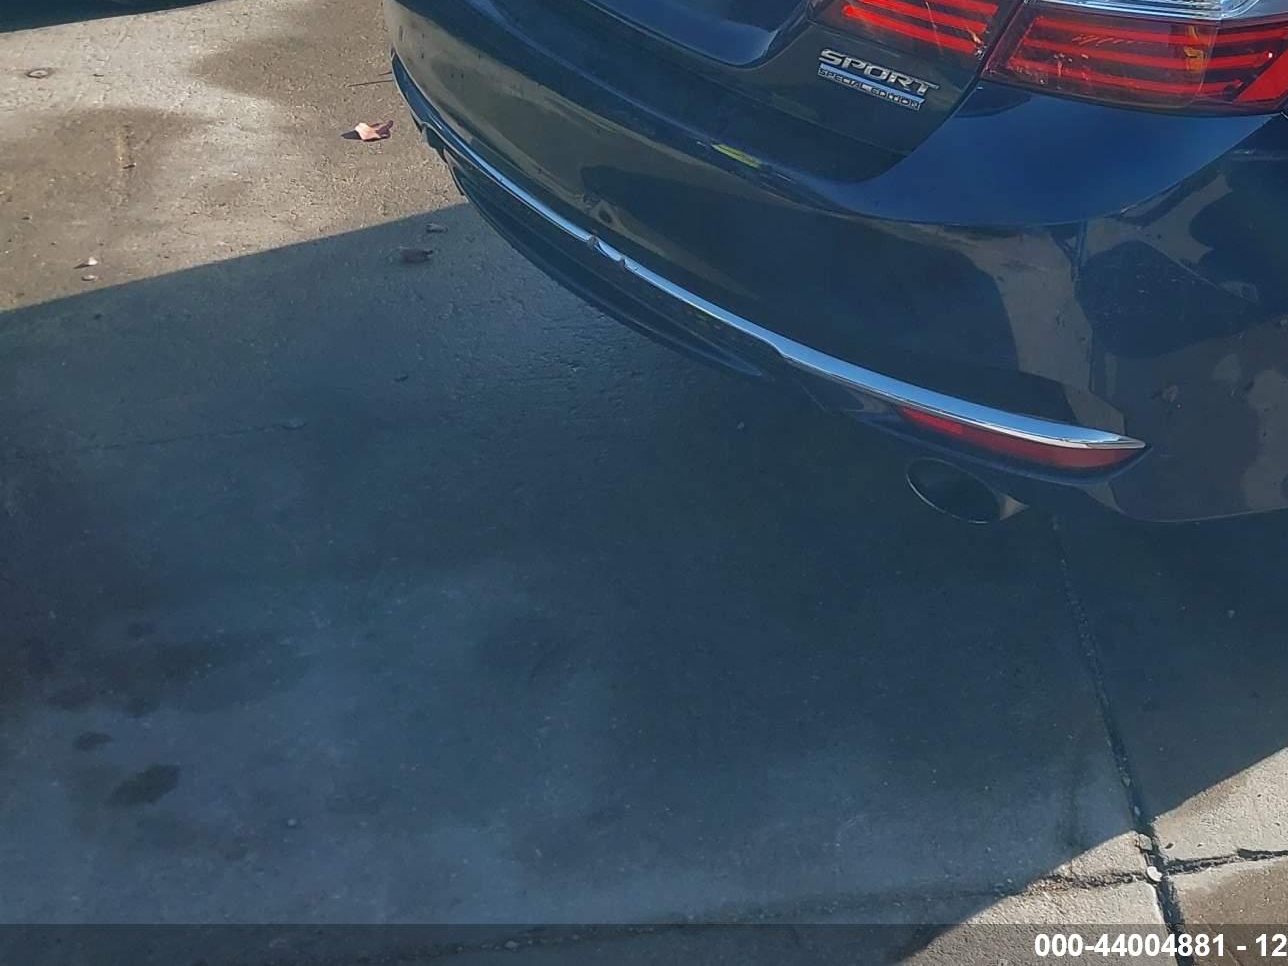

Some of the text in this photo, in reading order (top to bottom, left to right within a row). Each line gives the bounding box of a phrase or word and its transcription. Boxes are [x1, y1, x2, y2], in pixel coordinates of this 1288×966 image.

[818, 48, 941, 96] SPORT
[818, 67, 921, 111] SPECIAL EDITION
